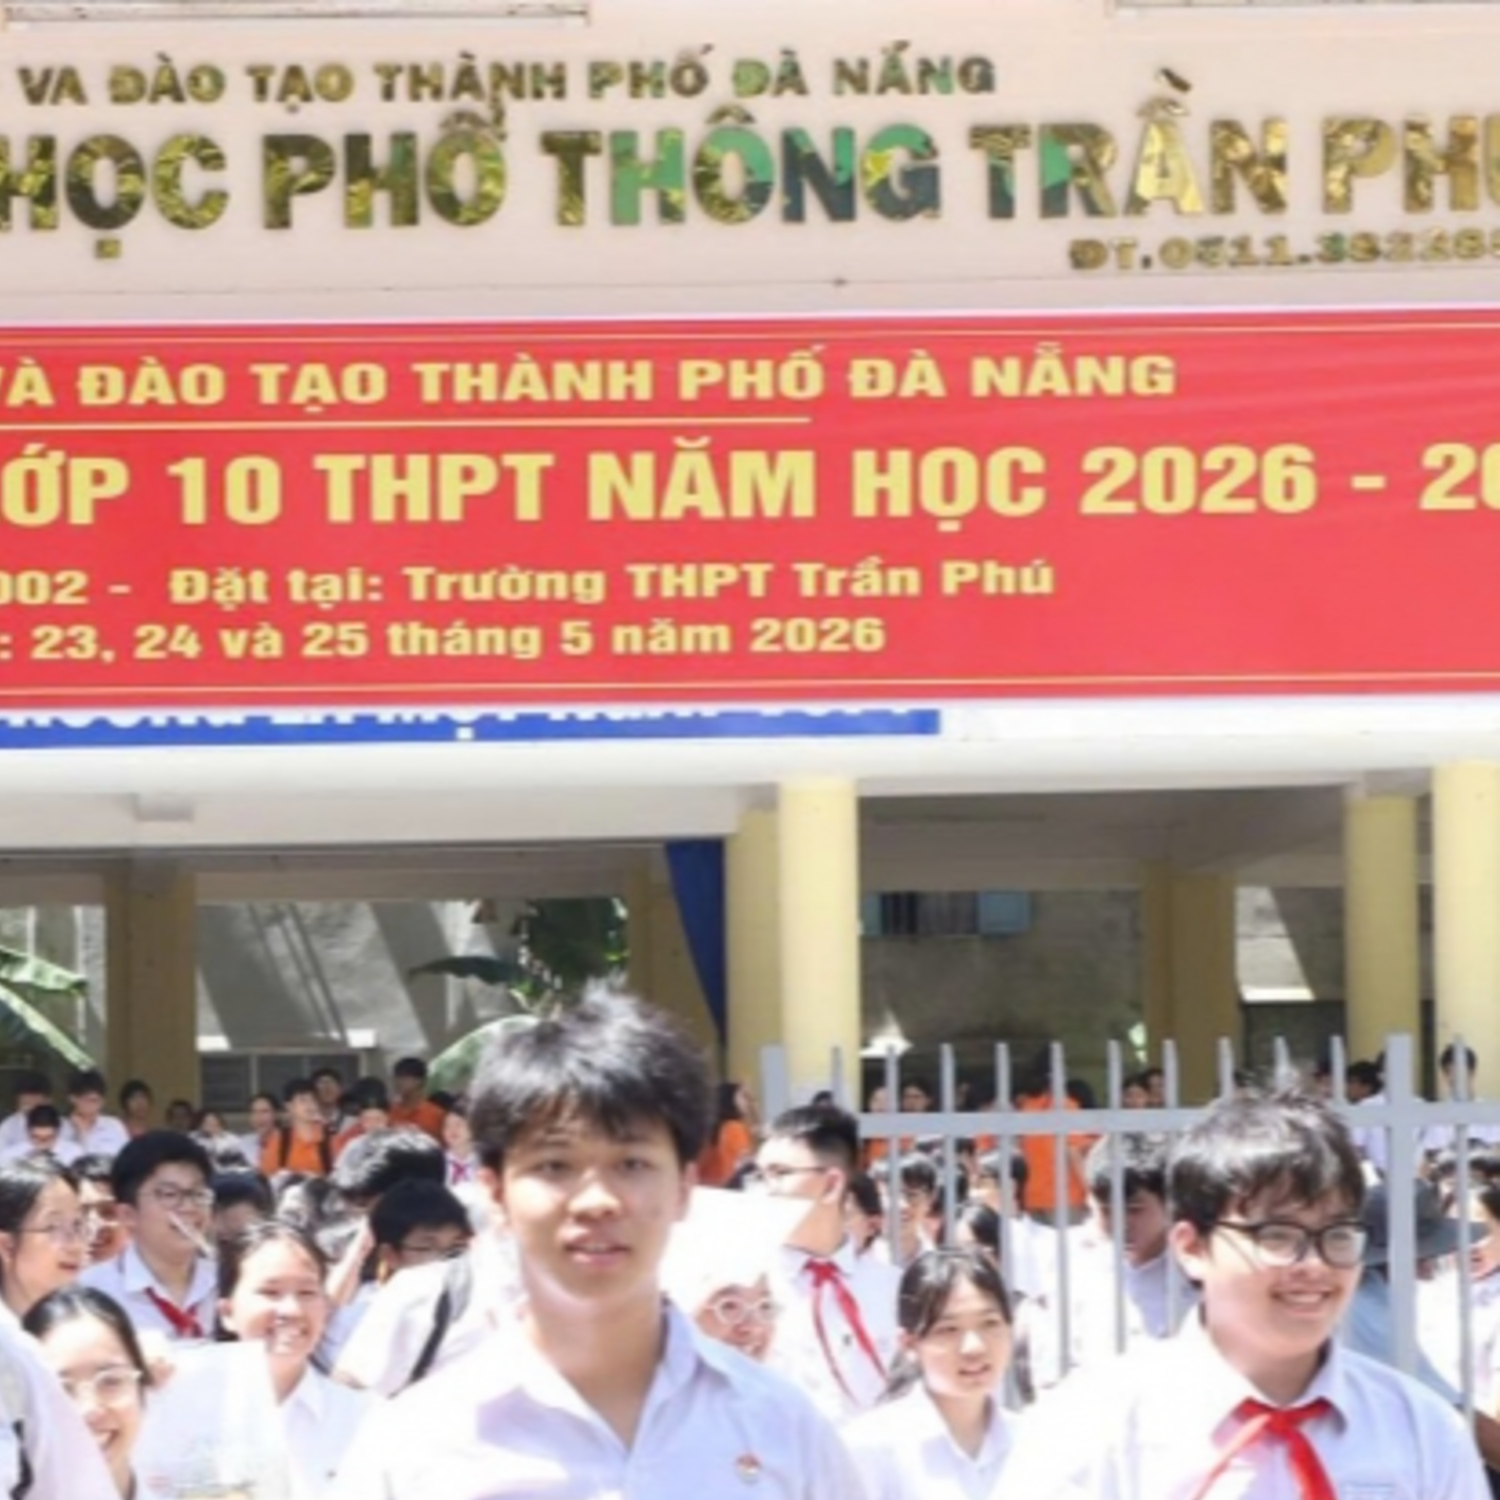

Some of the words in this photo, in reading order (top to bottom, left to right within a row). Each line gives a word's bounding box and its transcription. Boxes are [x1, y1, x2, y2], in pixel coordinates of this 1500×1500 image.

[108, 51, 227, 105] ĐÀO
[245, 64, 355, 114] TẠO
[374, 51, 568, 103] THÀNH
[587, 43, 714, 100] PHỐ
[731, 48, 809, 98] ĐÀ
[262, 100, 508, 229] PHỔ
[540, 105, 941, 224] THÔNG
[968, 67, 1288, 220] TRẦN
[1321, 112, 1500, 214] PH
[77, 357, 225, 408] ĐÀO
[249, 362, 387, 413] TẠO
[412, 353, 653, 402] THÀNH
[678, 345, 825, 400] PHỐ
[848, 349, 946, 398] ĐÀ
[971, 341, 1176, 397] NẴNG
[167, 454, 282, 526] 10
[313, 452, 554, 523] THPT
[587, 436, 816, 520] NĂM
[851, 446, 1046, 533] HỌC
[1079, 443, 1318, 515] 2026
[1350, 474, 1387, 490] -
[108, 584, 132, 593] -
[169, 567, 269, 611] Đặt
[288, 566, 384, 610] tại:
[402, 565, 606, 604] Trường
[625, 563, 774, 598] THPT
[792, 556, 921, 597] Trần
[941, 558, 1054, 596] Phú
[133, 625, 202, 660] 24
[219, 622, 284, 659] và
[302, 623, 369, 658] 25
[386, 620, 542, 659] tháng
[560, 621, 593, 656] 5
[612, 618, 730, 654] năm
[749, 617, 885, 653] 2026
